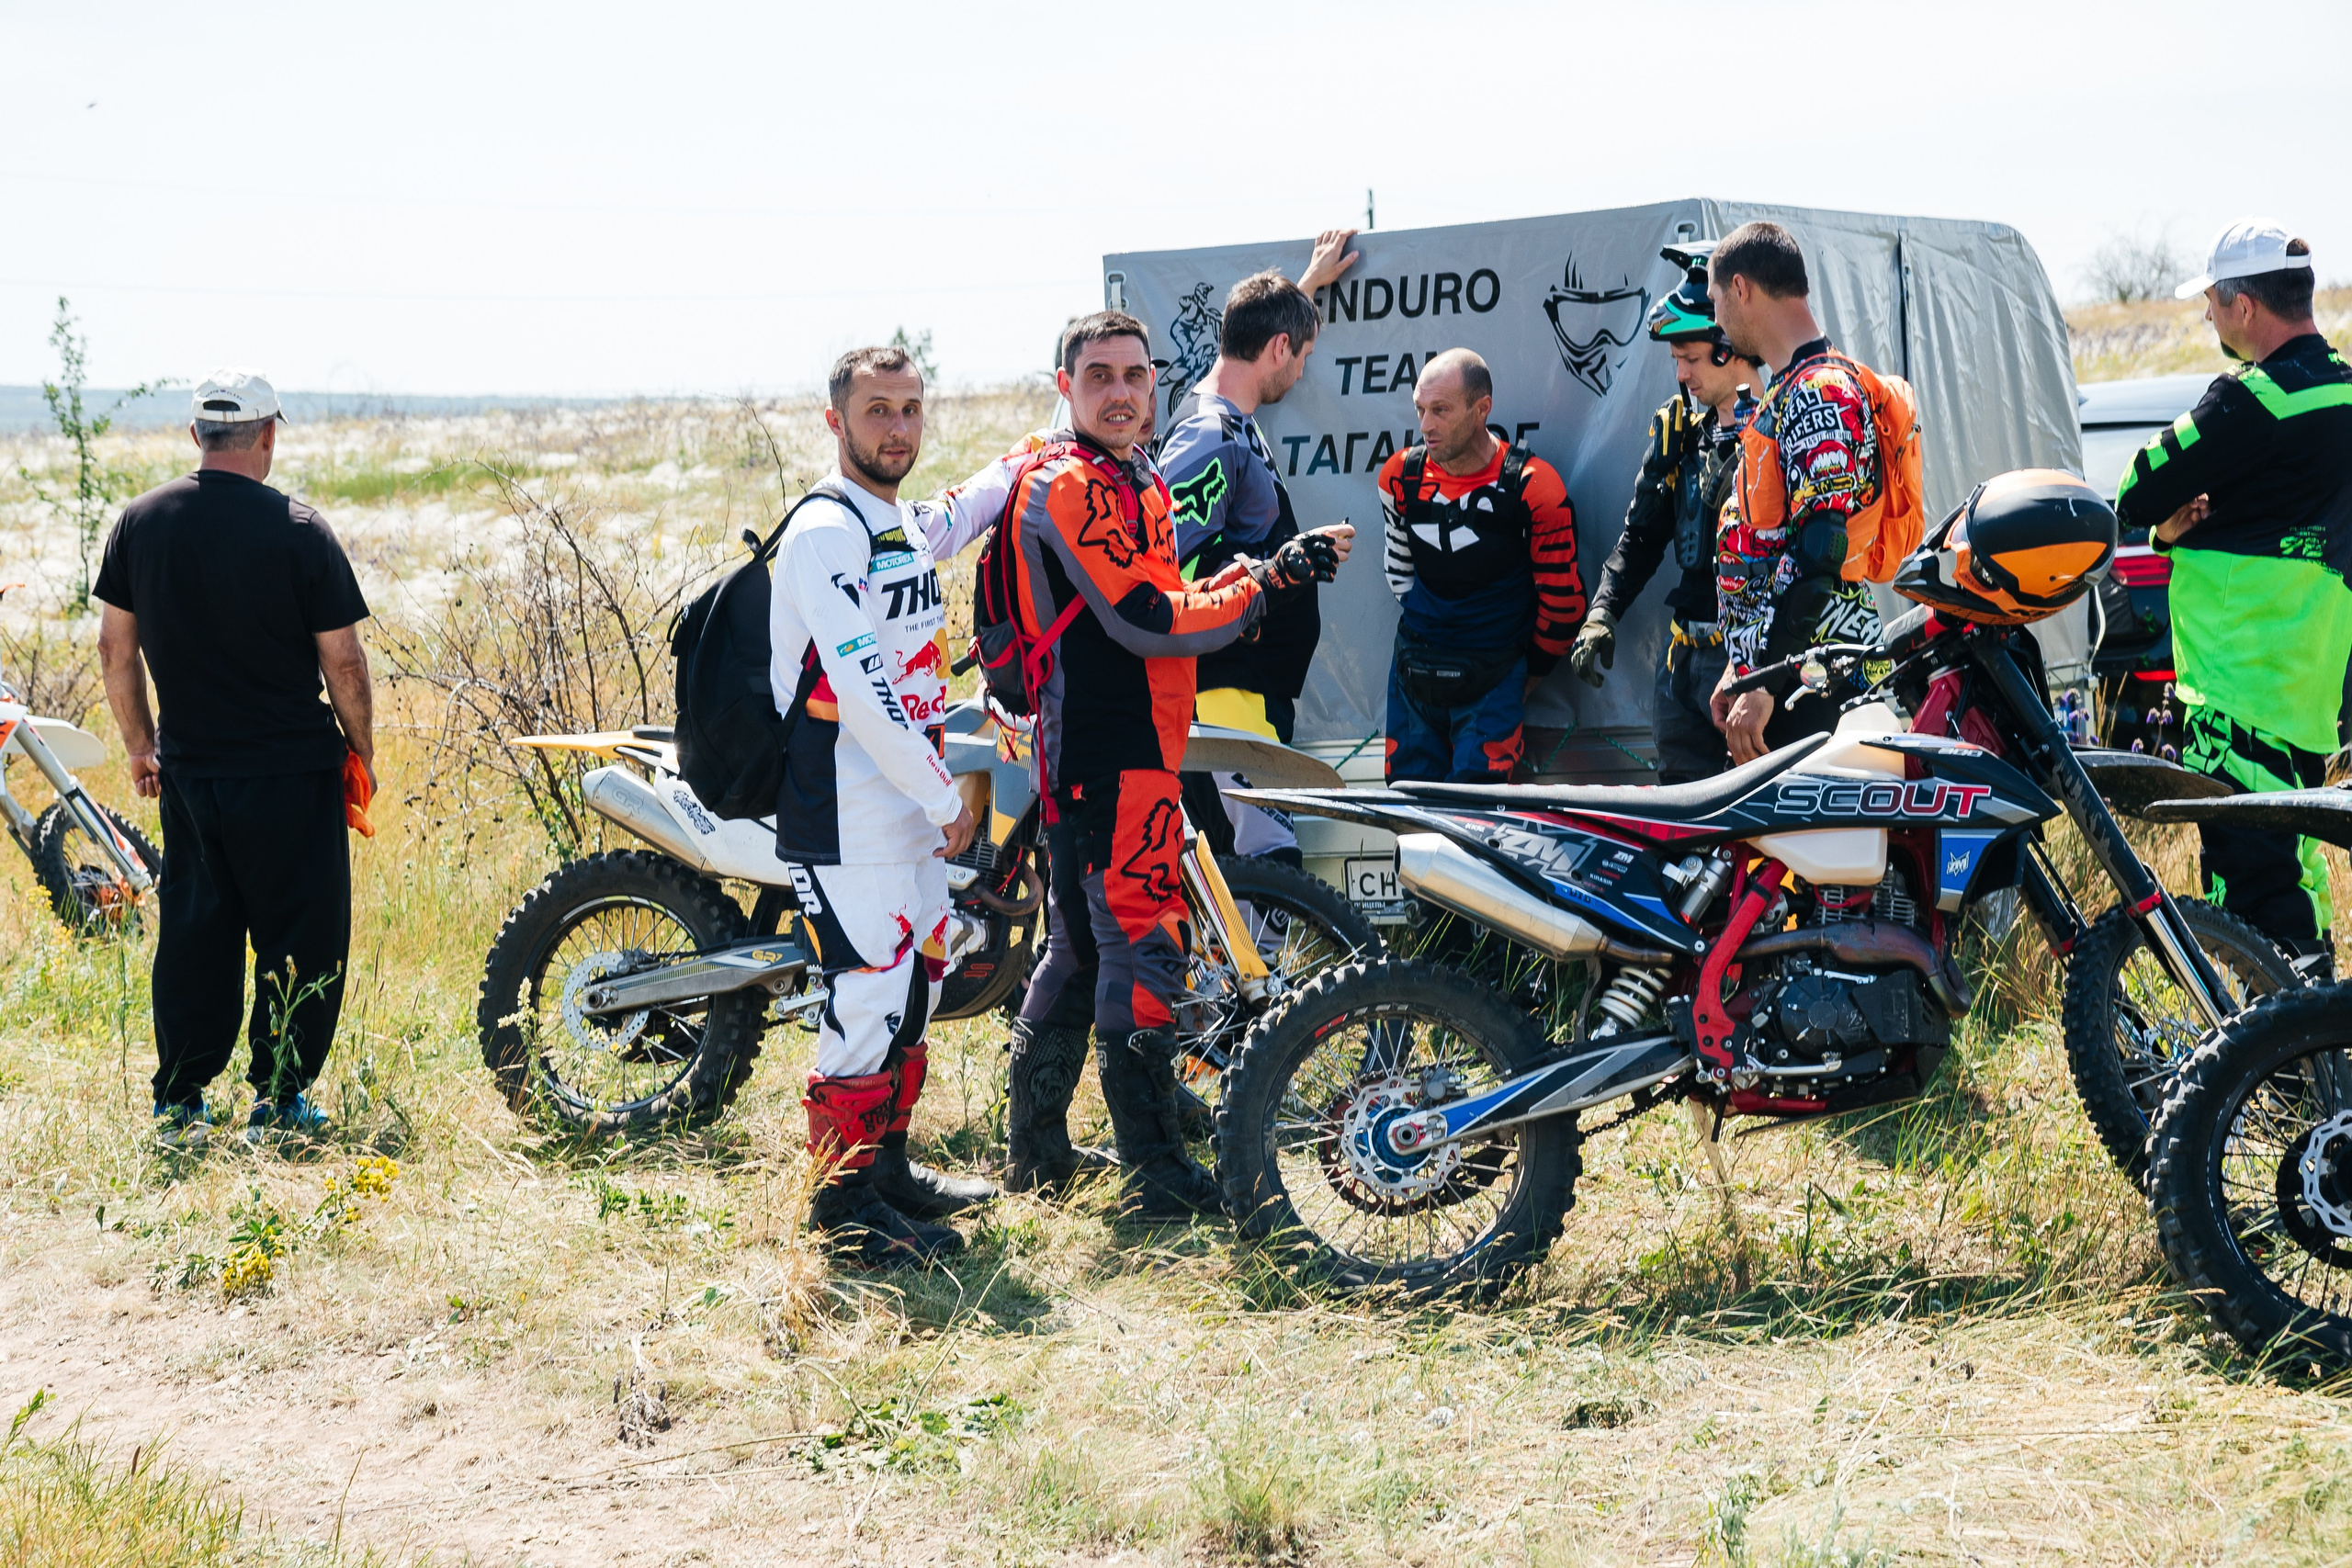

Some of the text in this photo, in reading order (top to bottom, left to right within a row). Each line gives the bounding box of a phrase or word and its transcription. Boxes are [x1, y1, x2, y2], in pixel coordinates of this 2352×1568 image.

[1335, 351, 1439, 396] TEA
[876, 553, 913, 570] MOTOREX
[881, 567, 942, 621] THO
[905, 625, 920, 634] THE
[921, 619, 936, 629] FIRST
[871, 676, 909, 731] THO
[1774, 782, 1992, 818] SCOUT
[786, 863, 823, 917] OR
